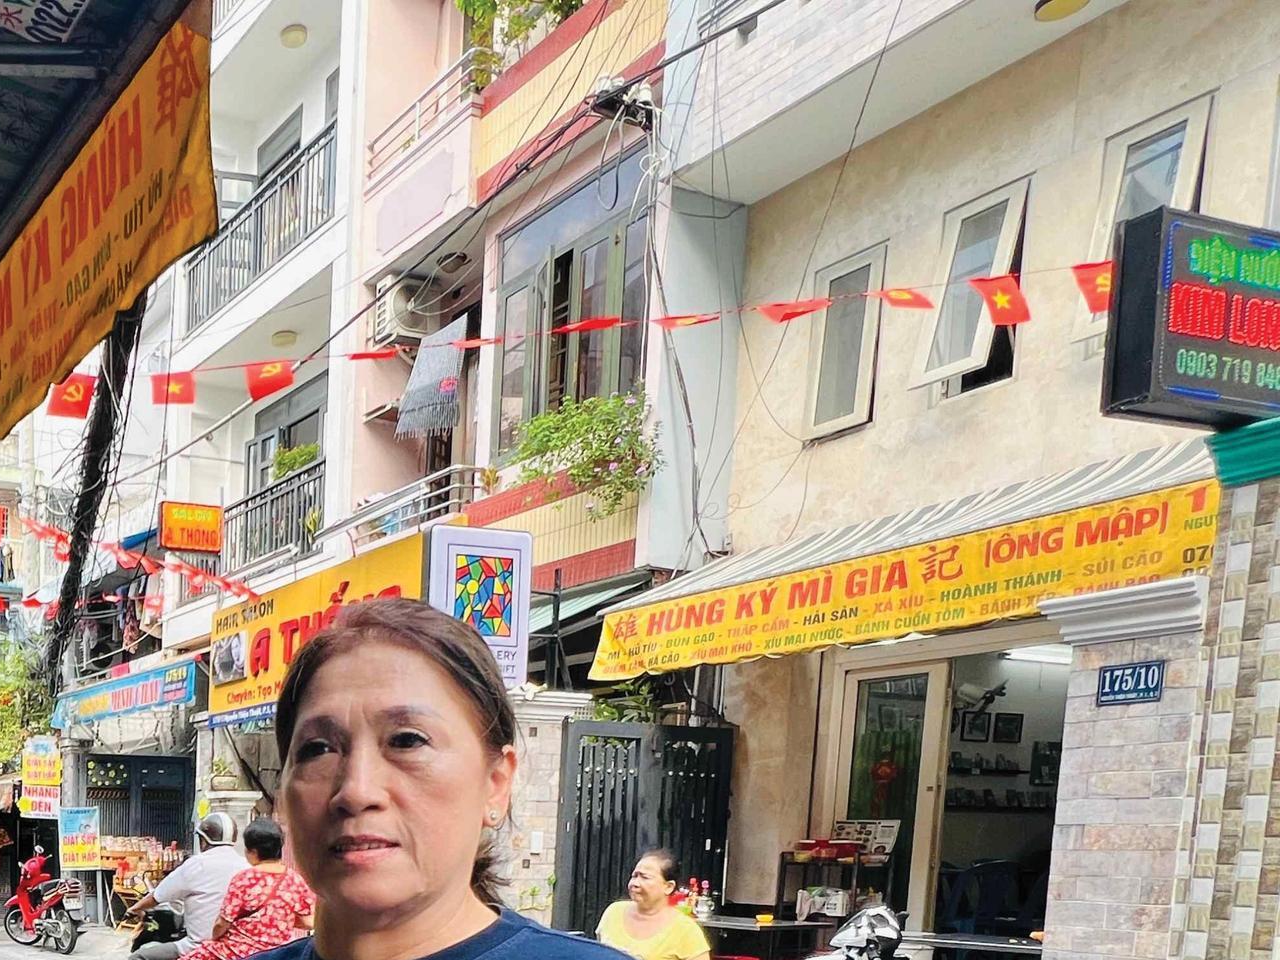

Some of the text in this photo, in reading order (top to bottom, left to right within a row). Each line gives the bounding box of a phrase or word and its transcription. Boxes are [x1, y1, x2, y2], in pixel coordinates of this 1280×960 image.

[1229, 294, 1280, 350] LON
[1182, 544, 1214, 564] 07
[787, 570, 833, 610] MÌ
[844, 560, 908, 599] GIA
[496, 650, 517, 660] ERY
[1103, 666, 1158, 692] 175/10
